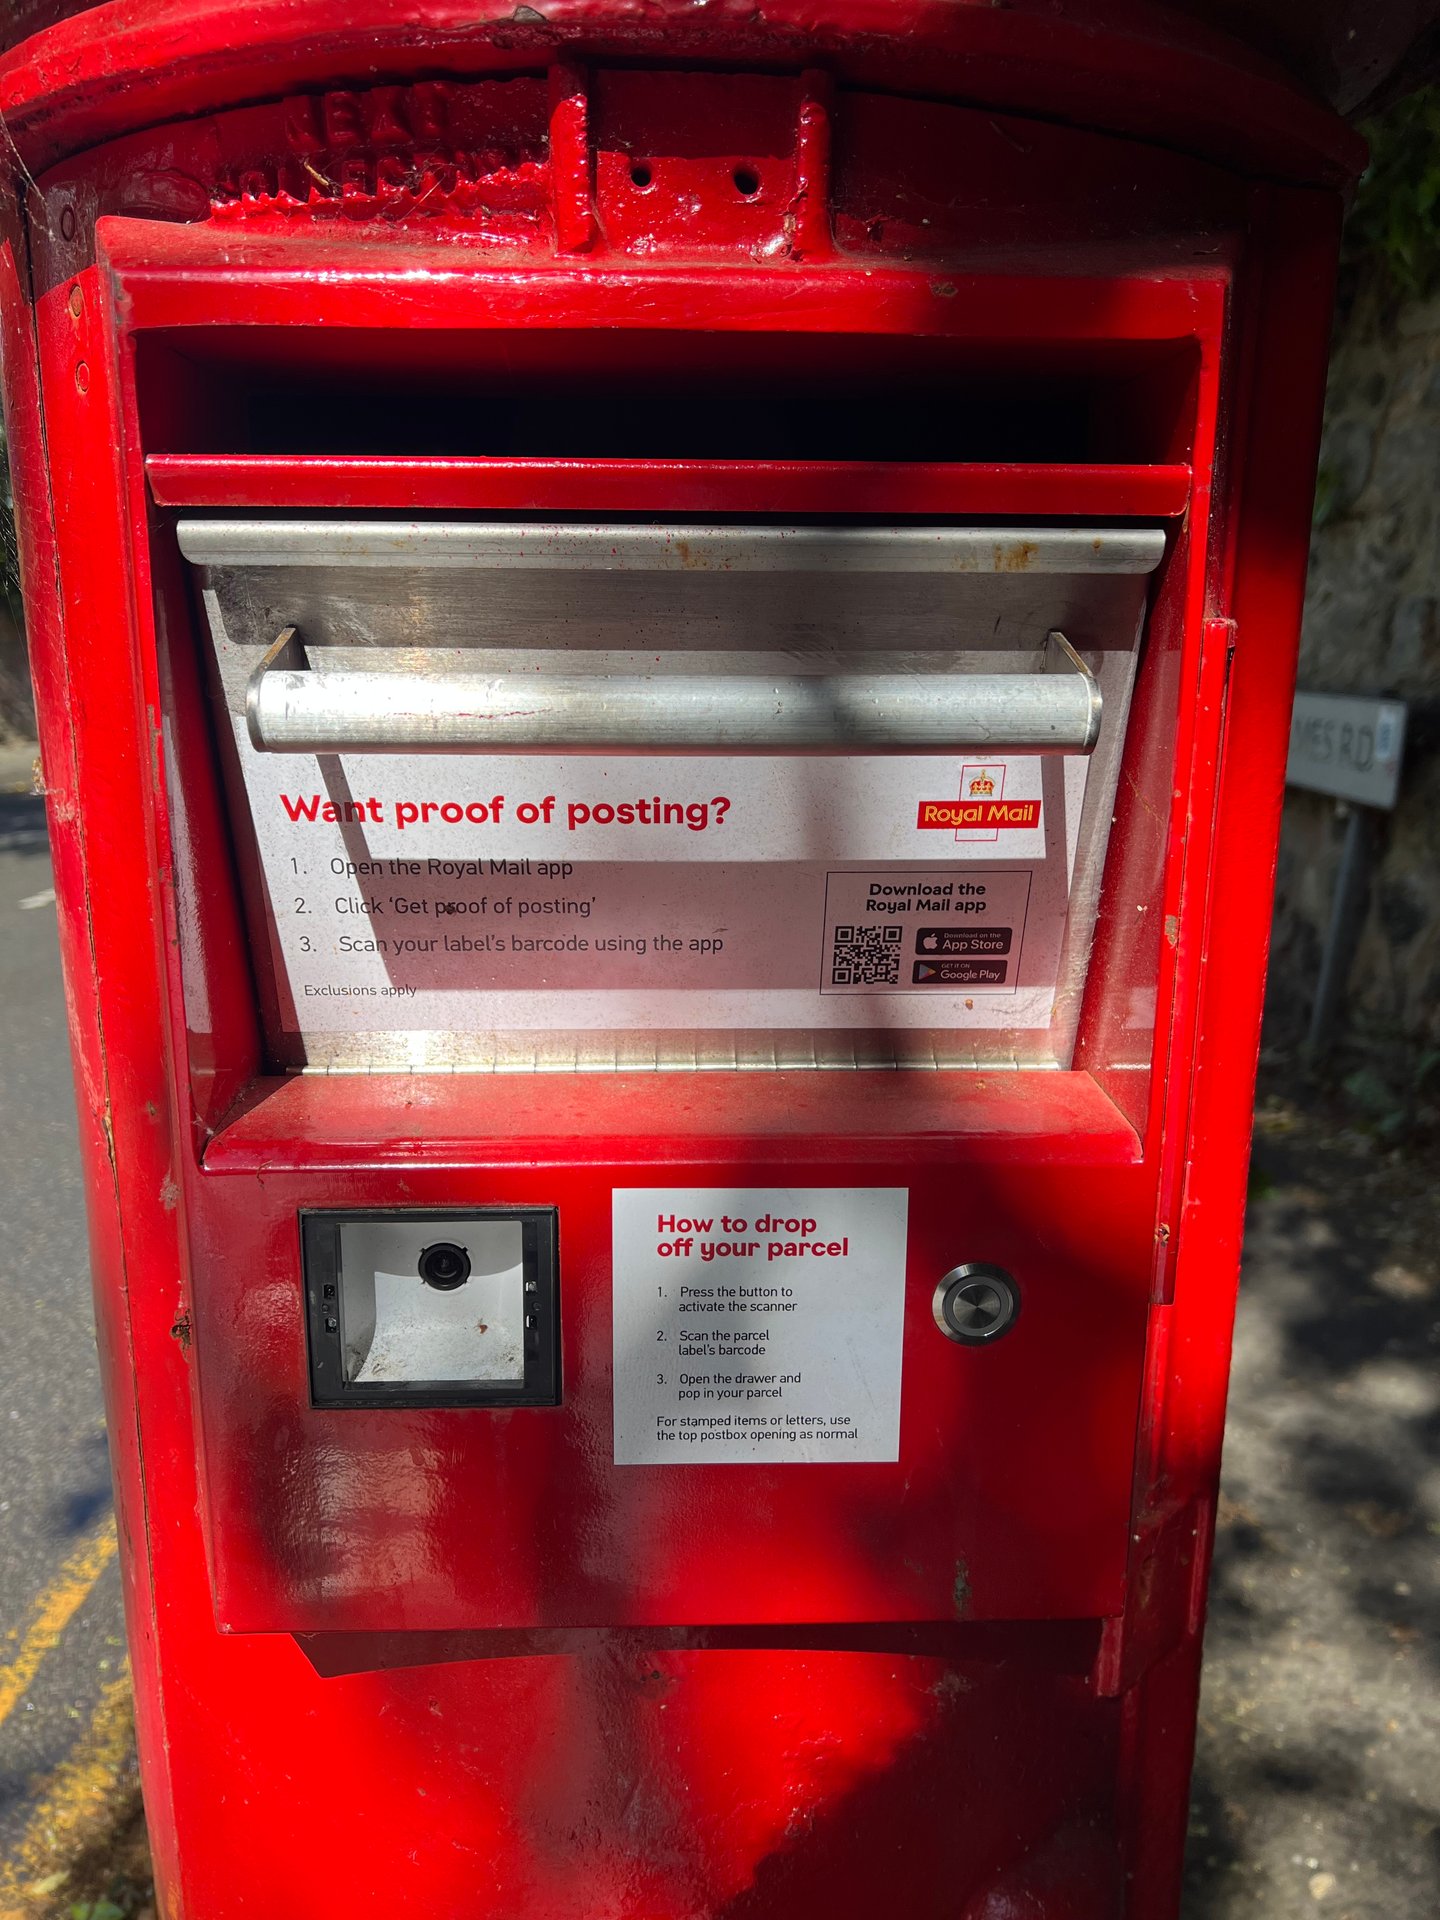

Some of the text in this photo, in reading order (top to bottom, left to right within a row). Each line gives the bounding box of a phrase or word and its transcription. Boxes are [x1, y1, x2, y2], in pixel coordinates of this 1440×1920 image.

[280, 794, 731, 830] Want proof of posting?
[924, 805, 1033, 825] Royal Mail
[290, 858, 573, 878] 1. Open the Royal Mail app
[869, 883, 986, 896] Download the
[295, 898, 312, 914] 2.
[335, 897, 383, 915] Click
[435, 897, 488, 917] proof
[493, 897, 513, 915] of
[866, 899, 986, 914] Royal Mail app
[299, 936, 317, 952] 3.
[339, 936, 387, 953] Scan
[393, 939, 438, 955] your
[512, 934, 589, 952] barcode
[595, 936, 647, 955] using
[653, 935, 683, 951] the
[689, 938, 722, 954] app
[942, 939, 1003, 951] App Store
[940, 970, 1000, 980] Google Play
[305, 985, 416, 998] Exclusions apply
[658, 1214, 816, 1237] How to drop
[657, 1238, 848, 1262] off your parcel
[658, 1286, 792, 1298] 1. Press the button to
[678, 1301, 798, 1312] activate the scanner
[656, 1330, 770, 1344] 2. Scan the parcel
[718, 1344, 766, 1356] barcode
[657, 1372, 801, 1386] 3. Open the drawer and
[678, 1387, 782, 1401] pop in your parcel
[657, 1416, 850, 1428] For stamped items or letters, use
[657, 1428, 858, 1442] the top postbox opening as normal
